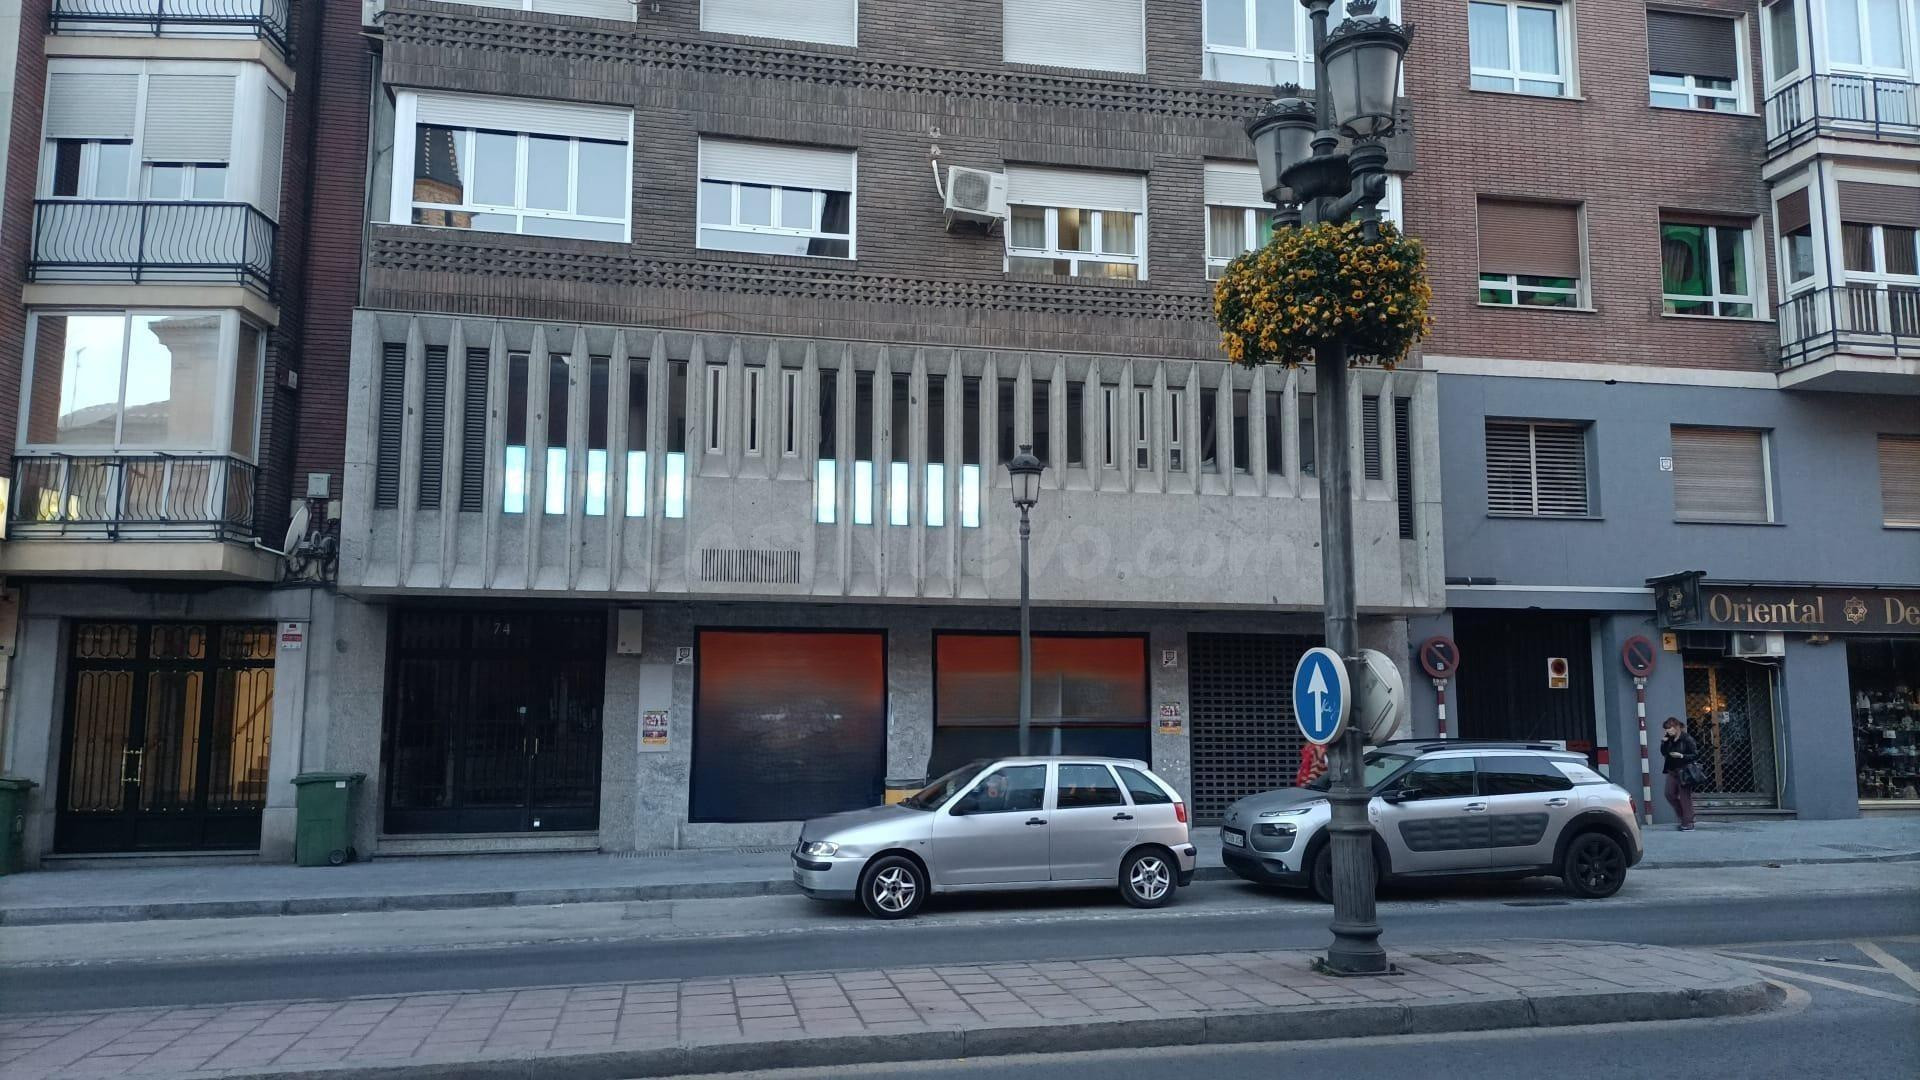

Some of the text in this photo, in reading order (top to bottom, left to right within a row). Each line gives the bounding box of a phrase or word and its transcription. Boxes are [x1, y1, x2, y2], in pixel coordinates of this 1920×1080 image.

[1710, 593, 1920, 625] Oriental De
[494, 622, 510, 636] 74
